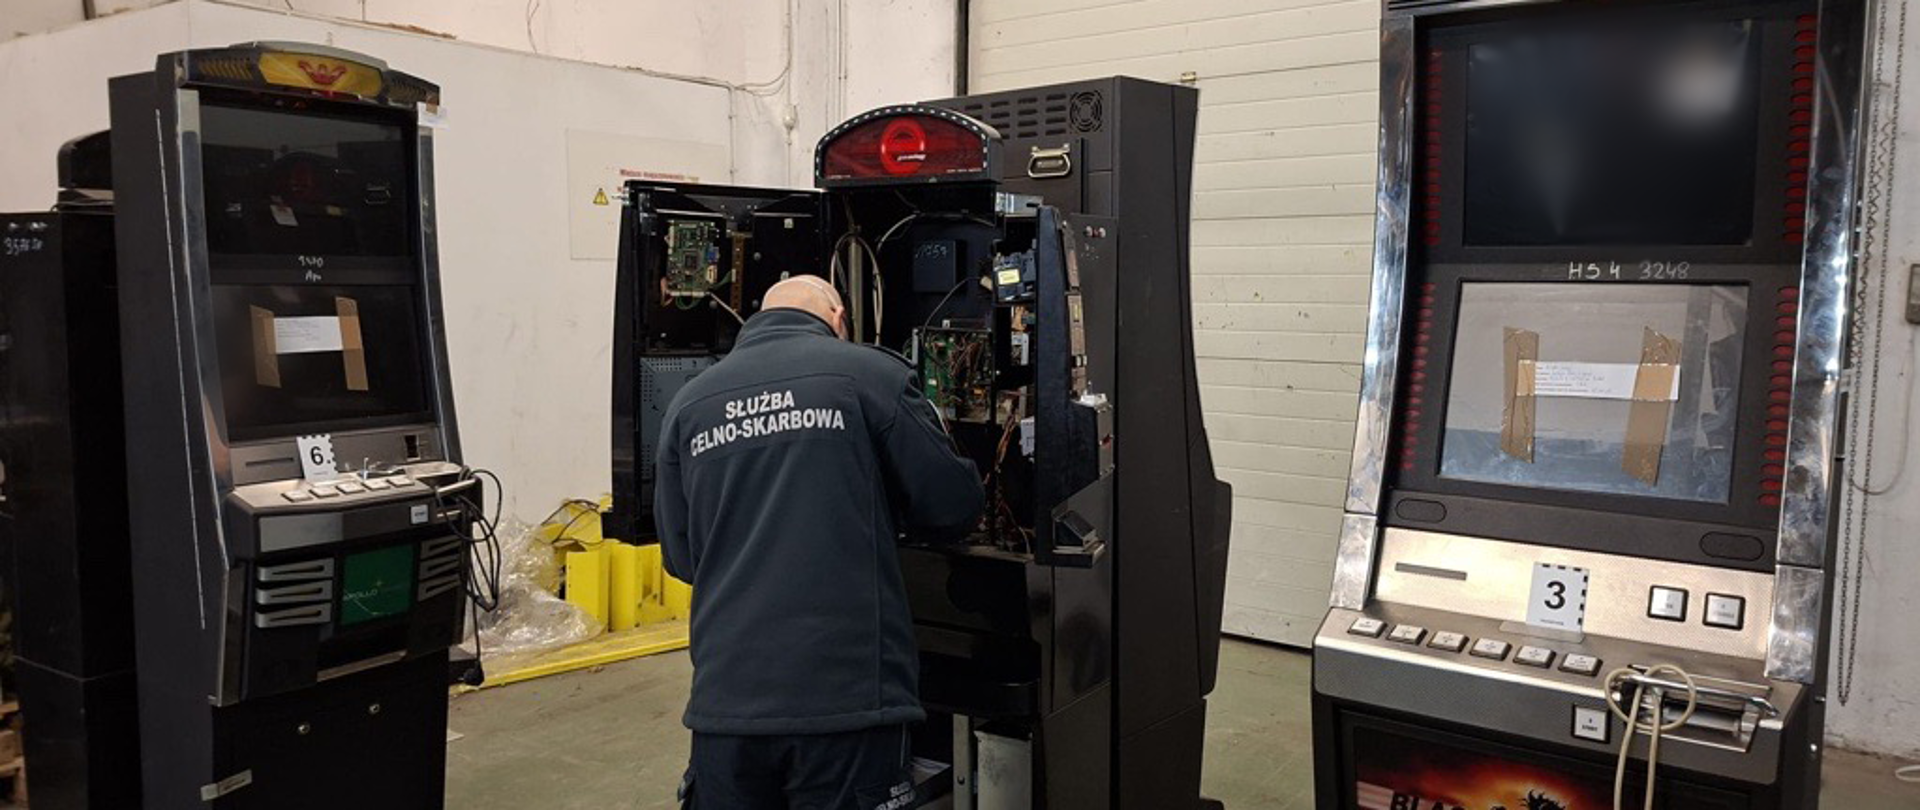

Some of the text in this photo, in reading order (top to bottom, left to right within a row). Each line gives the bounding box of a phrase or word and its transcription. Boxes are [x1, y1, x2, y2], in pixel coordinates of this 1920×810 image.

[1639, 260, 1690, 280] 3248
[726, 390, 795, 419] SŁUŻBA
[690, 408, 846, 457] CELNO-SKARBOWA
[1544, 581, 1566, 610] 3
[1390, 791, 1465, 810] BLA
